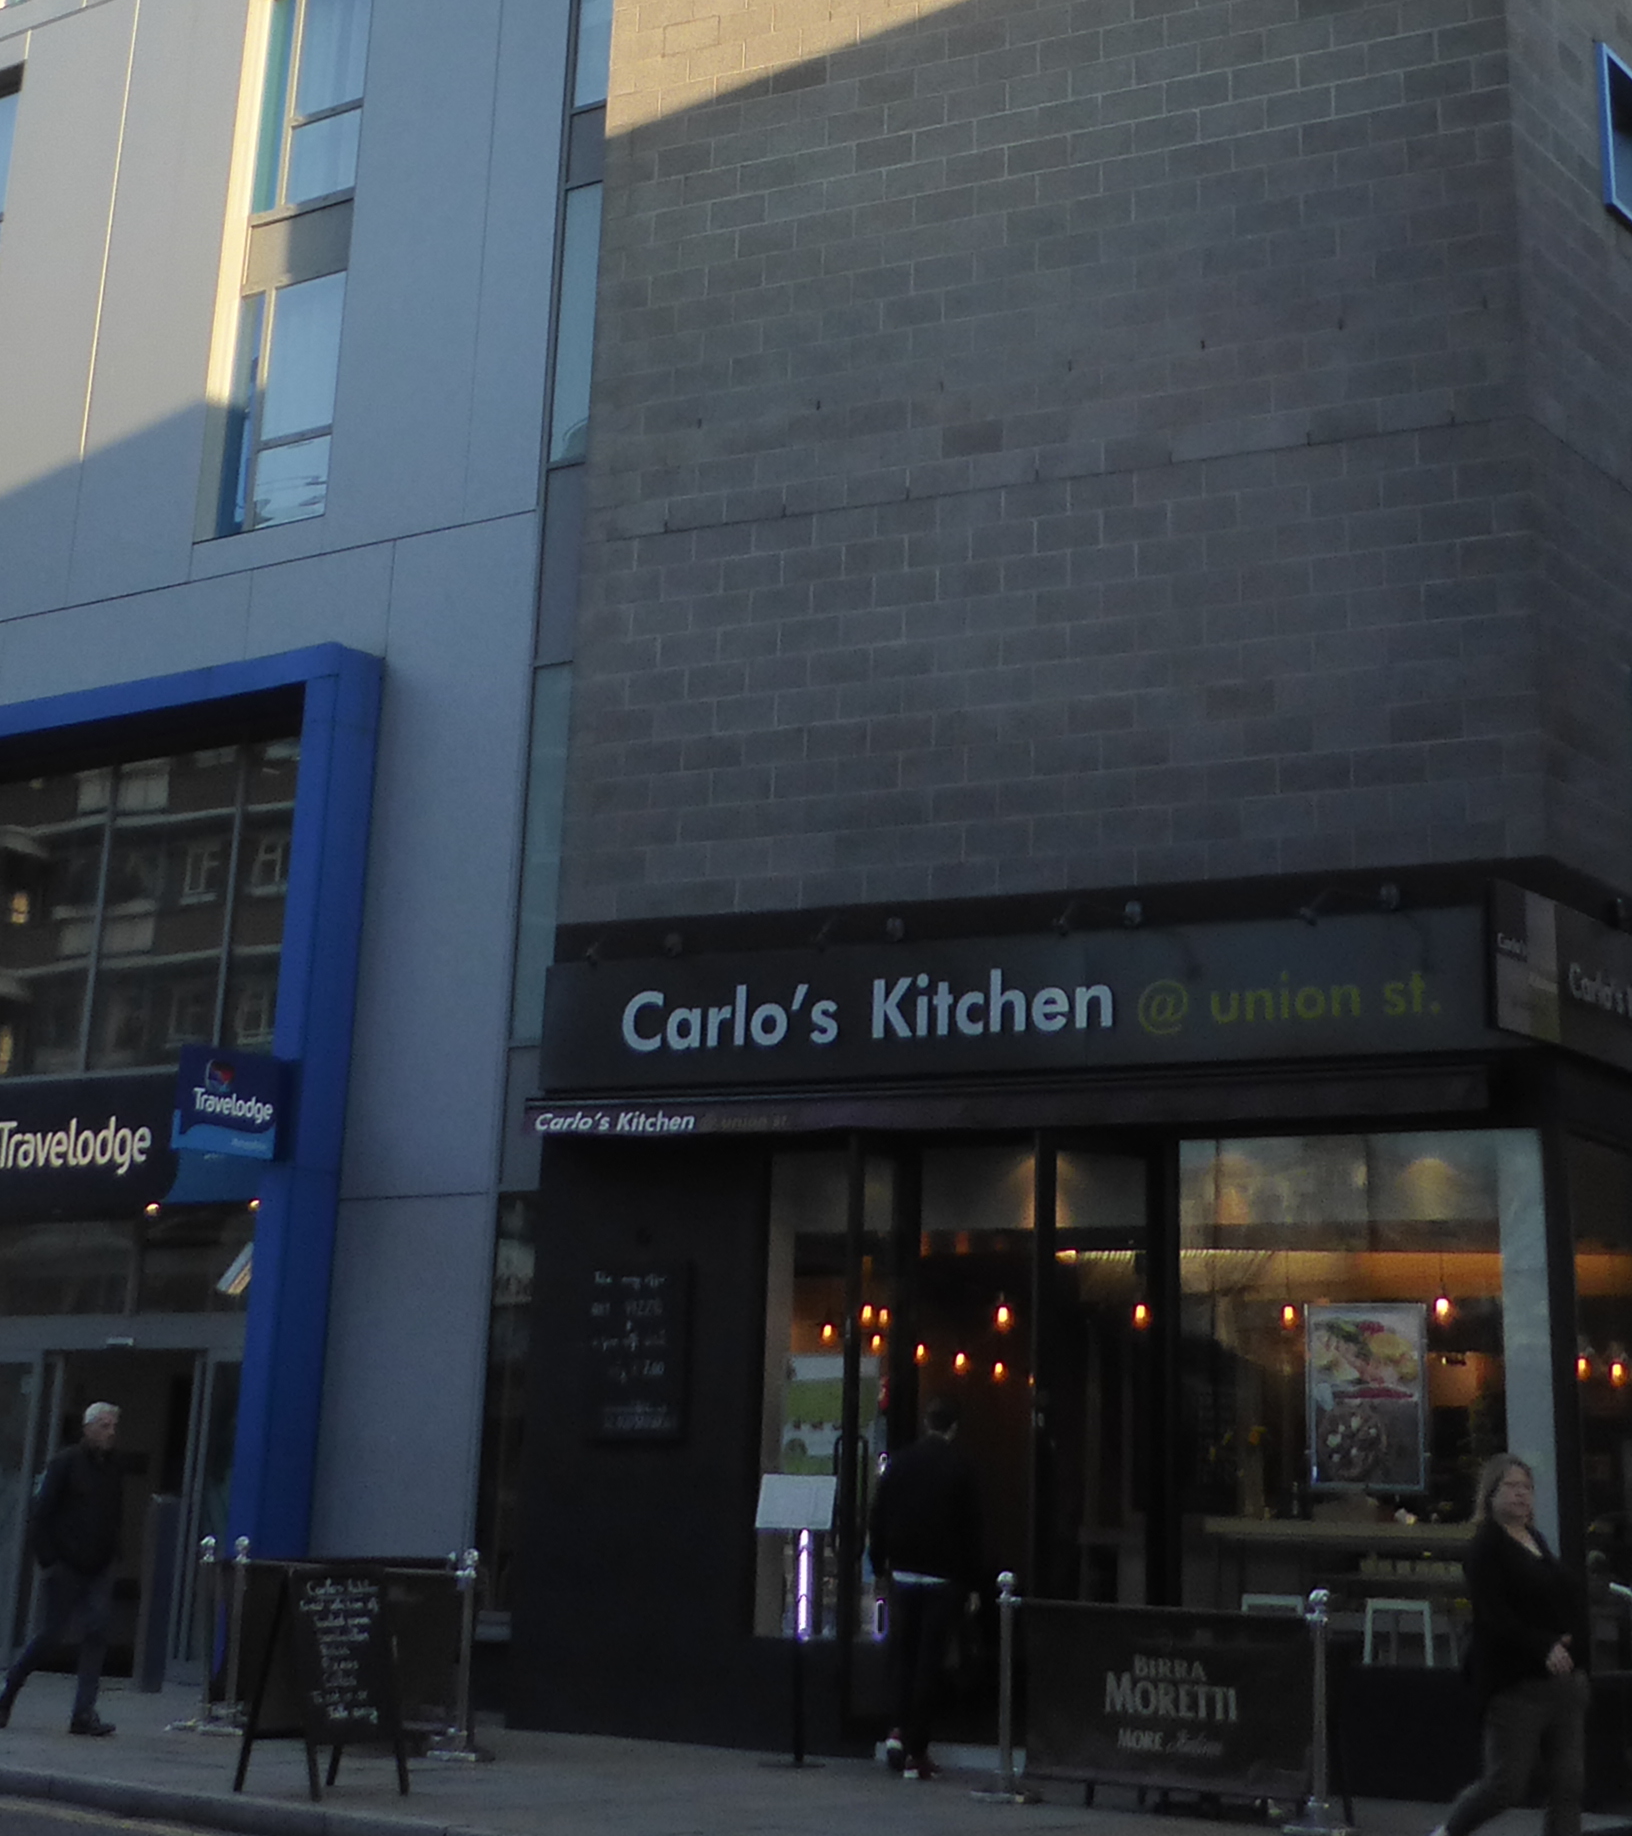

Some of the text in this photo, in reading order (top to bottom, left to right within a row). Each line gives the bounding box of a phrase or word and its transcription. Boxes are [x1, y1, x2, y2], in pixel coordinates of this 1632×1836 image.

[622, 968, 1441, 1052] Carlo's Kitchen @ union st.
[192, 1086, 274, 1124] Travelodge
[535, 1111, 610, 1131] Carlo's
[616, 1110, 695, 1132] Kitchen
[1133, 1653, 1207, 1682] BIRRA
[1104, 1670, 1237, 1723] MORETTI
[1117, 1727, 1165, 1752] MORE
